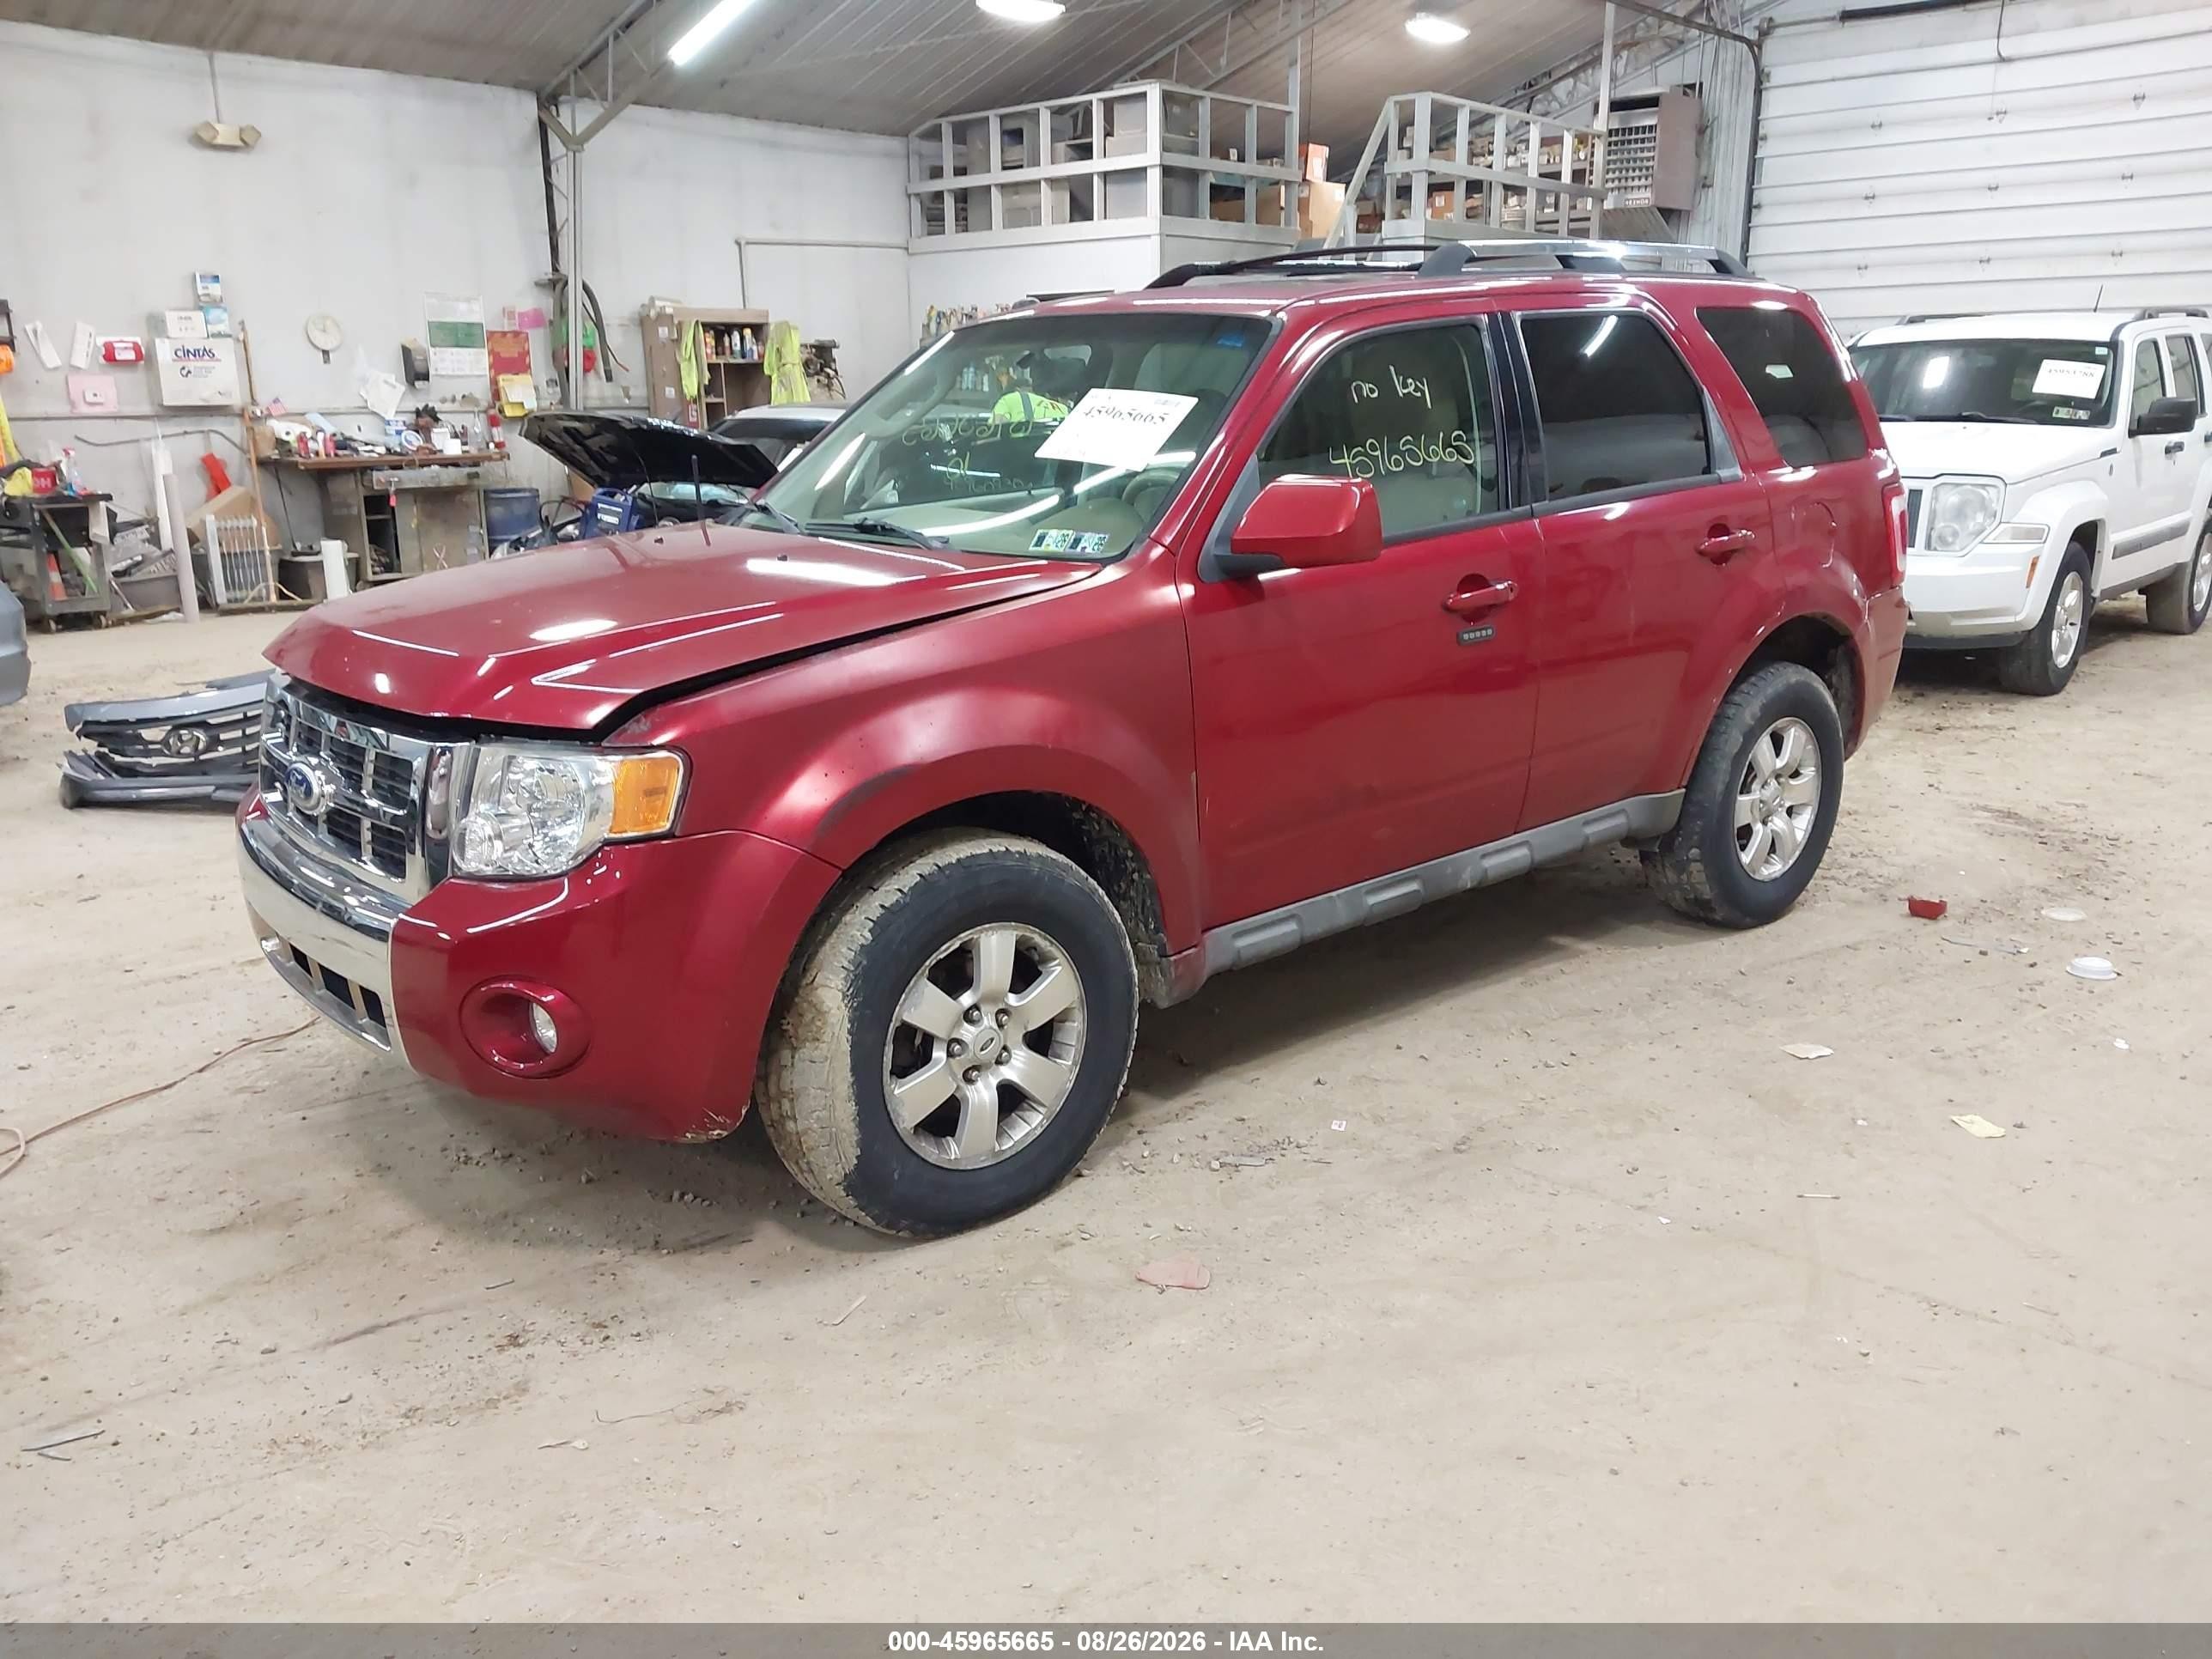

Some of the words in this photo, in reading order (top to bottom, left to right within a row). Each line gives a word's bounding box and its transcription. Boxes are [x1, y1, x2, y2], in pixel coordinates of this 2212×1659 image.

[1351, 380, 1380, 404] no
[1389, 364, 1432, 410] key
[1329, 430, 1475, 479] 45965665
